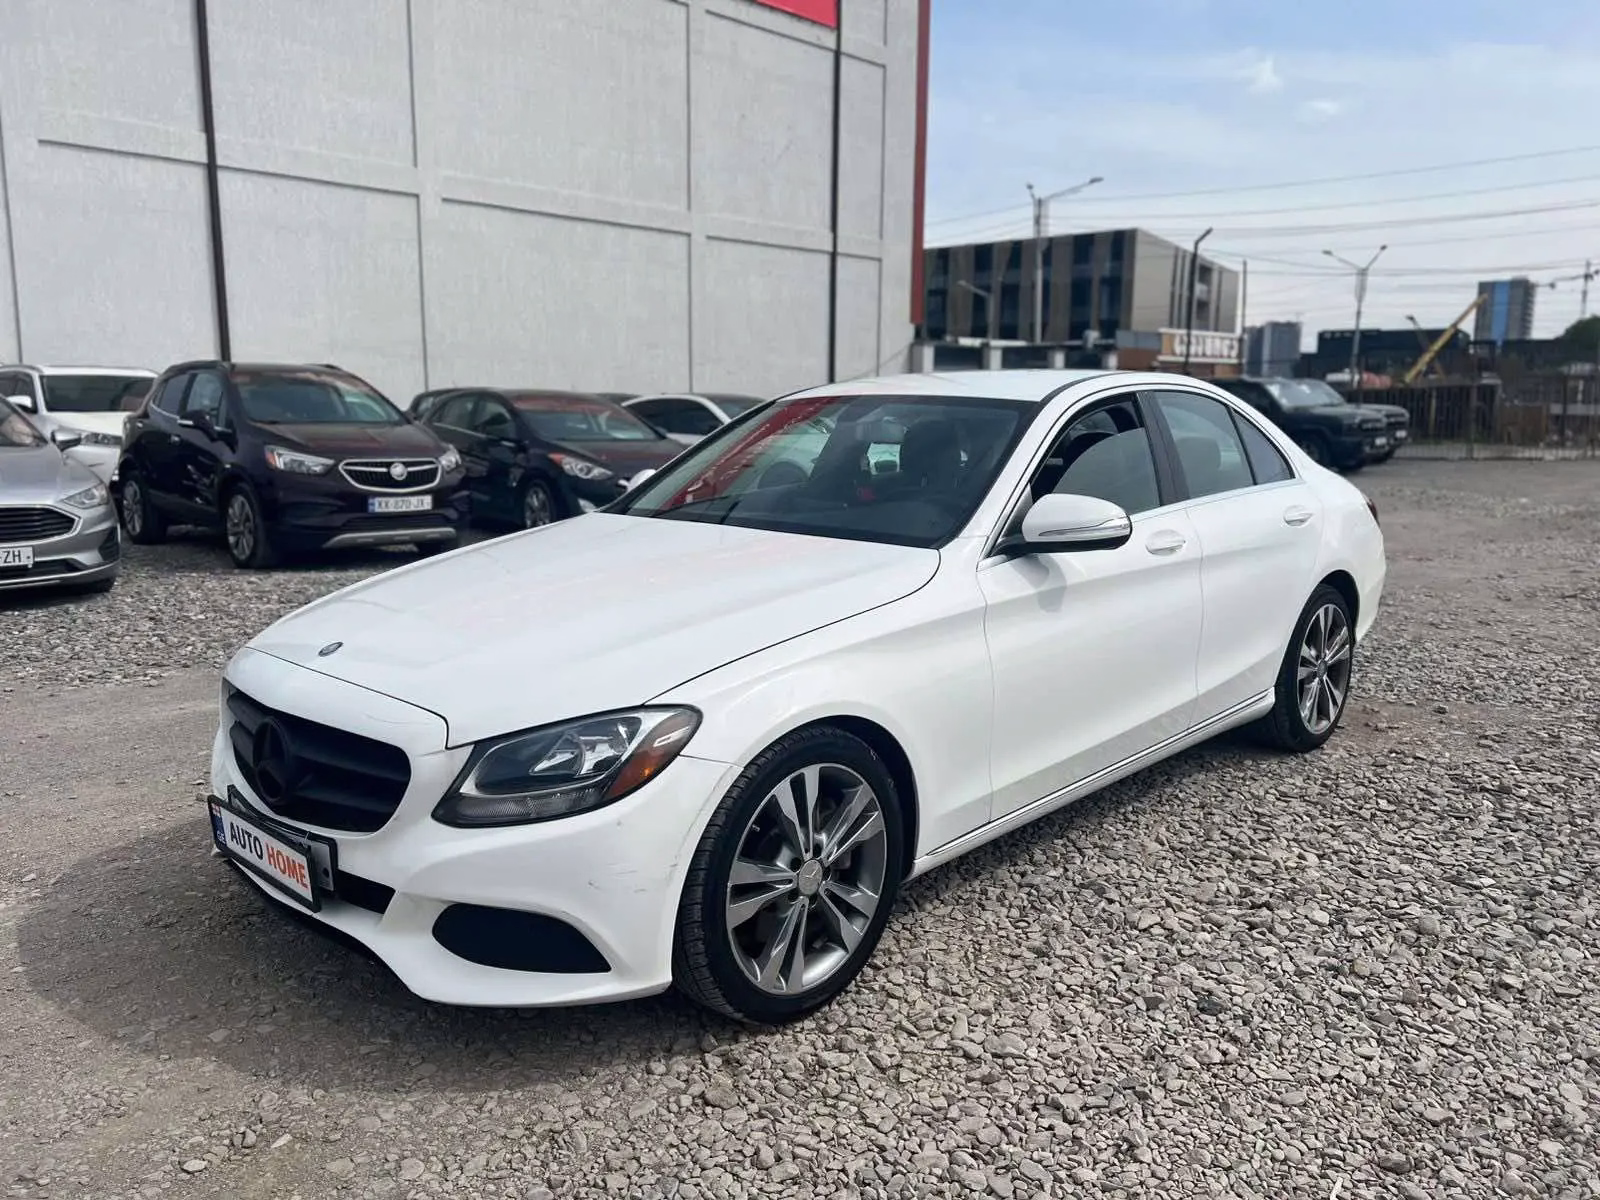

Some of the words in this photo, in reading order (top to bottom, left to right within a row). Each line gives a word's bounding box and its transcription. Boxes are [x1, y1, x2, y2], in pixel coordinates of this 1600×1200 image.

[0, 549, 22, 563] ZH
[229, 821, 263, 860] AUTO
[265, 842, 309, 889] HOME
